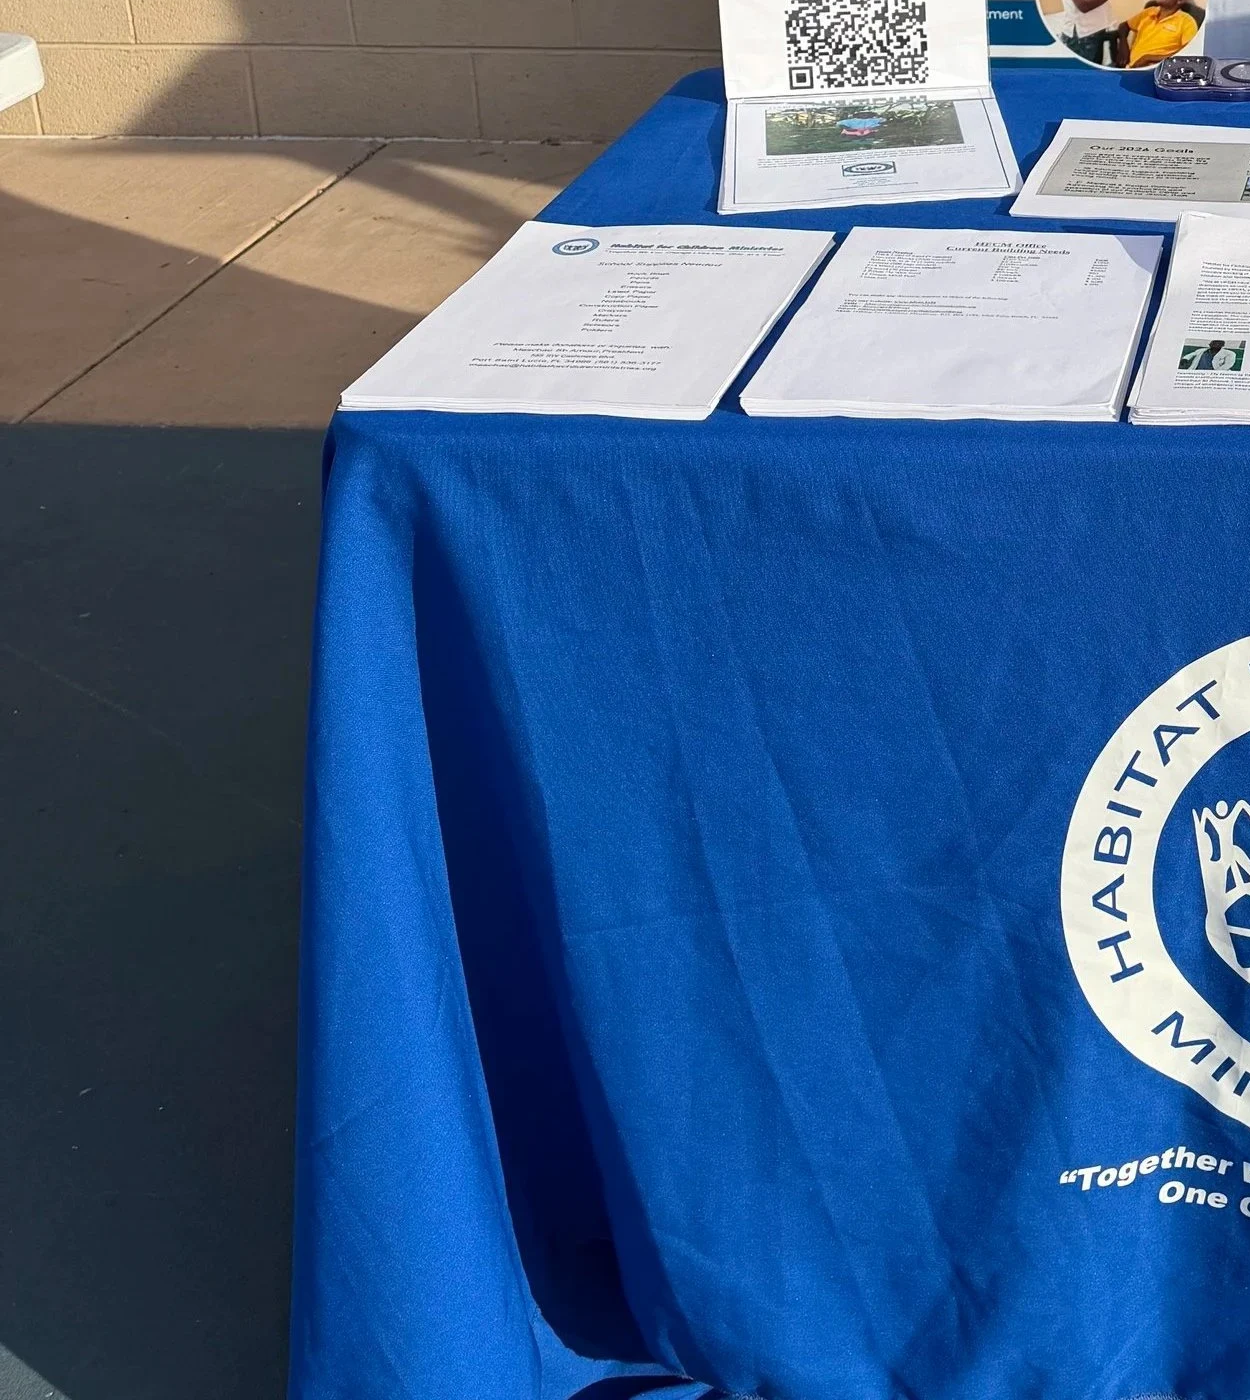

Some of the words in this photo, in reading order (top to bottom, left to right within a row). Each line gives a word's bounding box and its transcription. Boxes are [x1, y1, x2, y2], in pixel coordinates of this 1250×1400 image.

[1091, 680, 1221, 984] HABITAT
[1059, 1145, 1233, 1193] “Together
[1157, 1180, 1229, 1211] One
